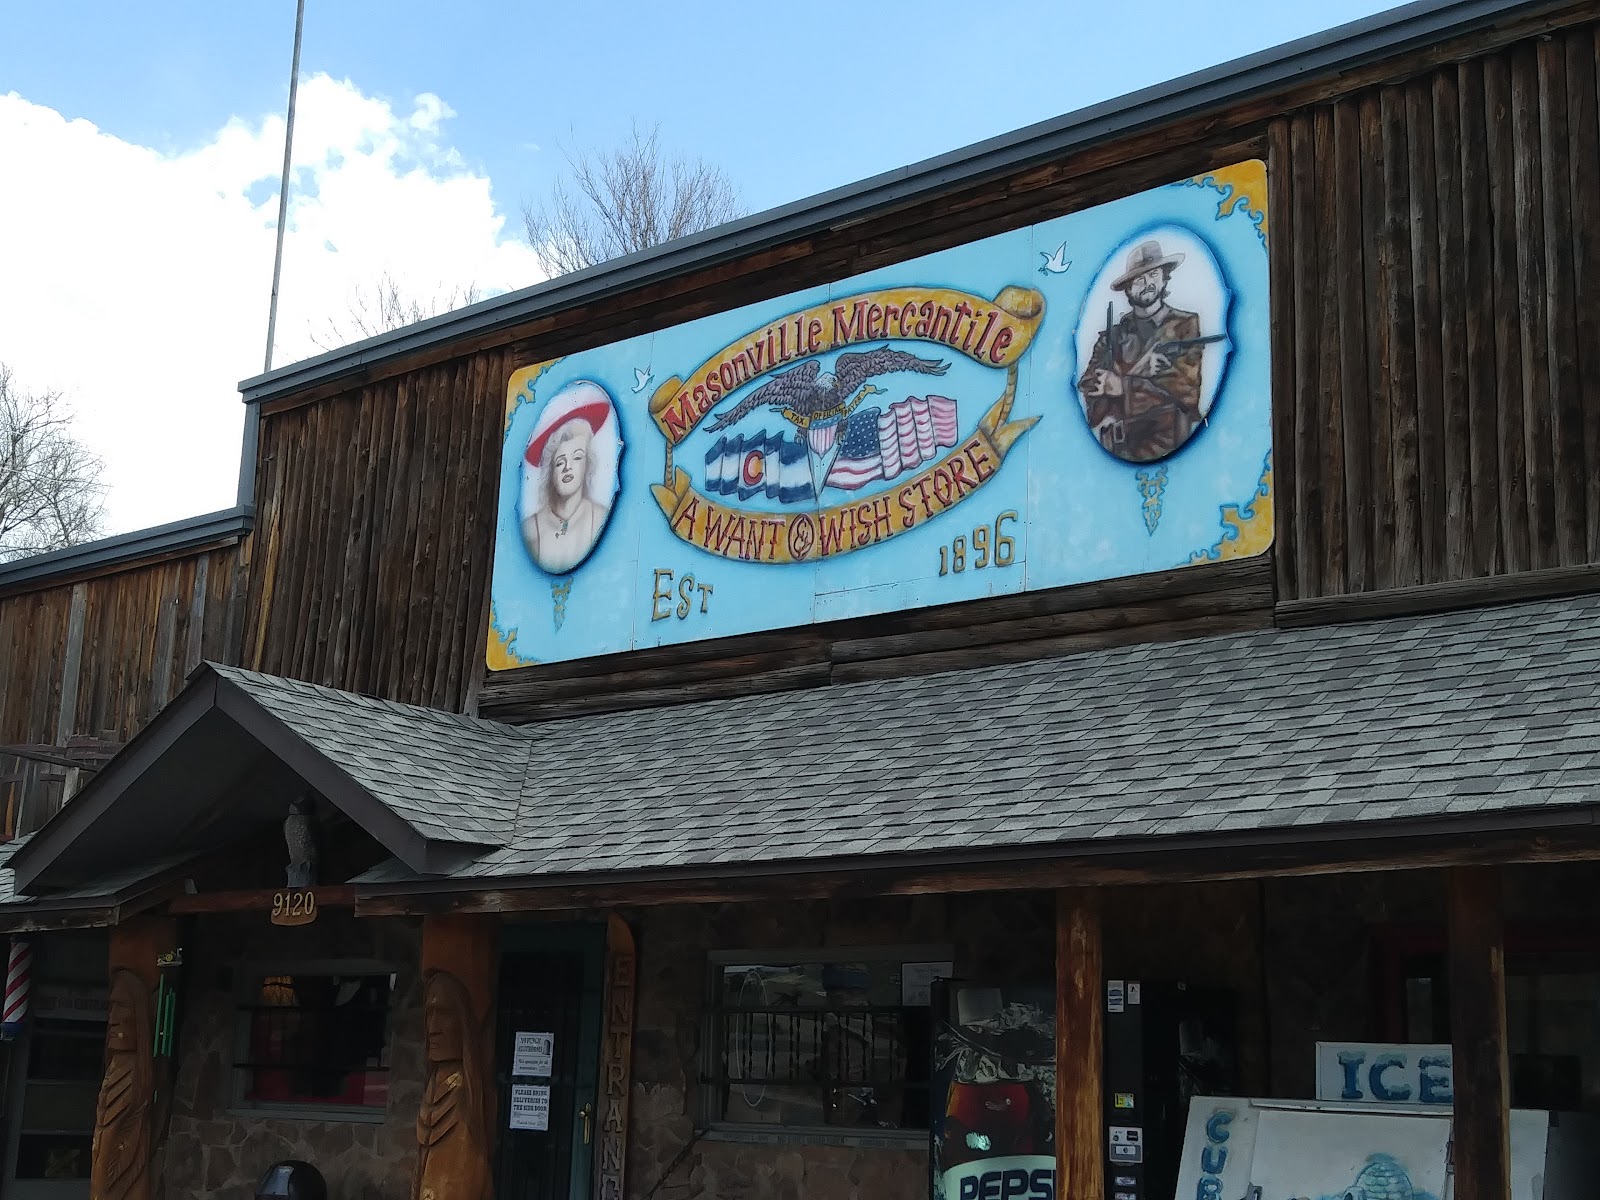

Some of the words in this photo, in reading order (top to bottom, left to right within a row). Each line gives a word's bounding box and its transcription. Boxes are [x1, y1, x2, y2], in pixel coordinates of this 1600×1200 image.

[660, 314, 822, 438] Masonville
[830, 298, 1015, 363] Mercantile
[790, 412, 805, 425] TAX
[673, 496, 696, 540] A
[704, 505, 786, 561] WANT
[819, 495, 893, 556] WISH
[898, 440, 996, 529] STORE
[938, 511, 1020, 577] 1896
[272, 891, 315, 916] 9120
[1337, 1050, 1453, 1103] ICE
[961, 1169, 1057, 1200] PEPS
